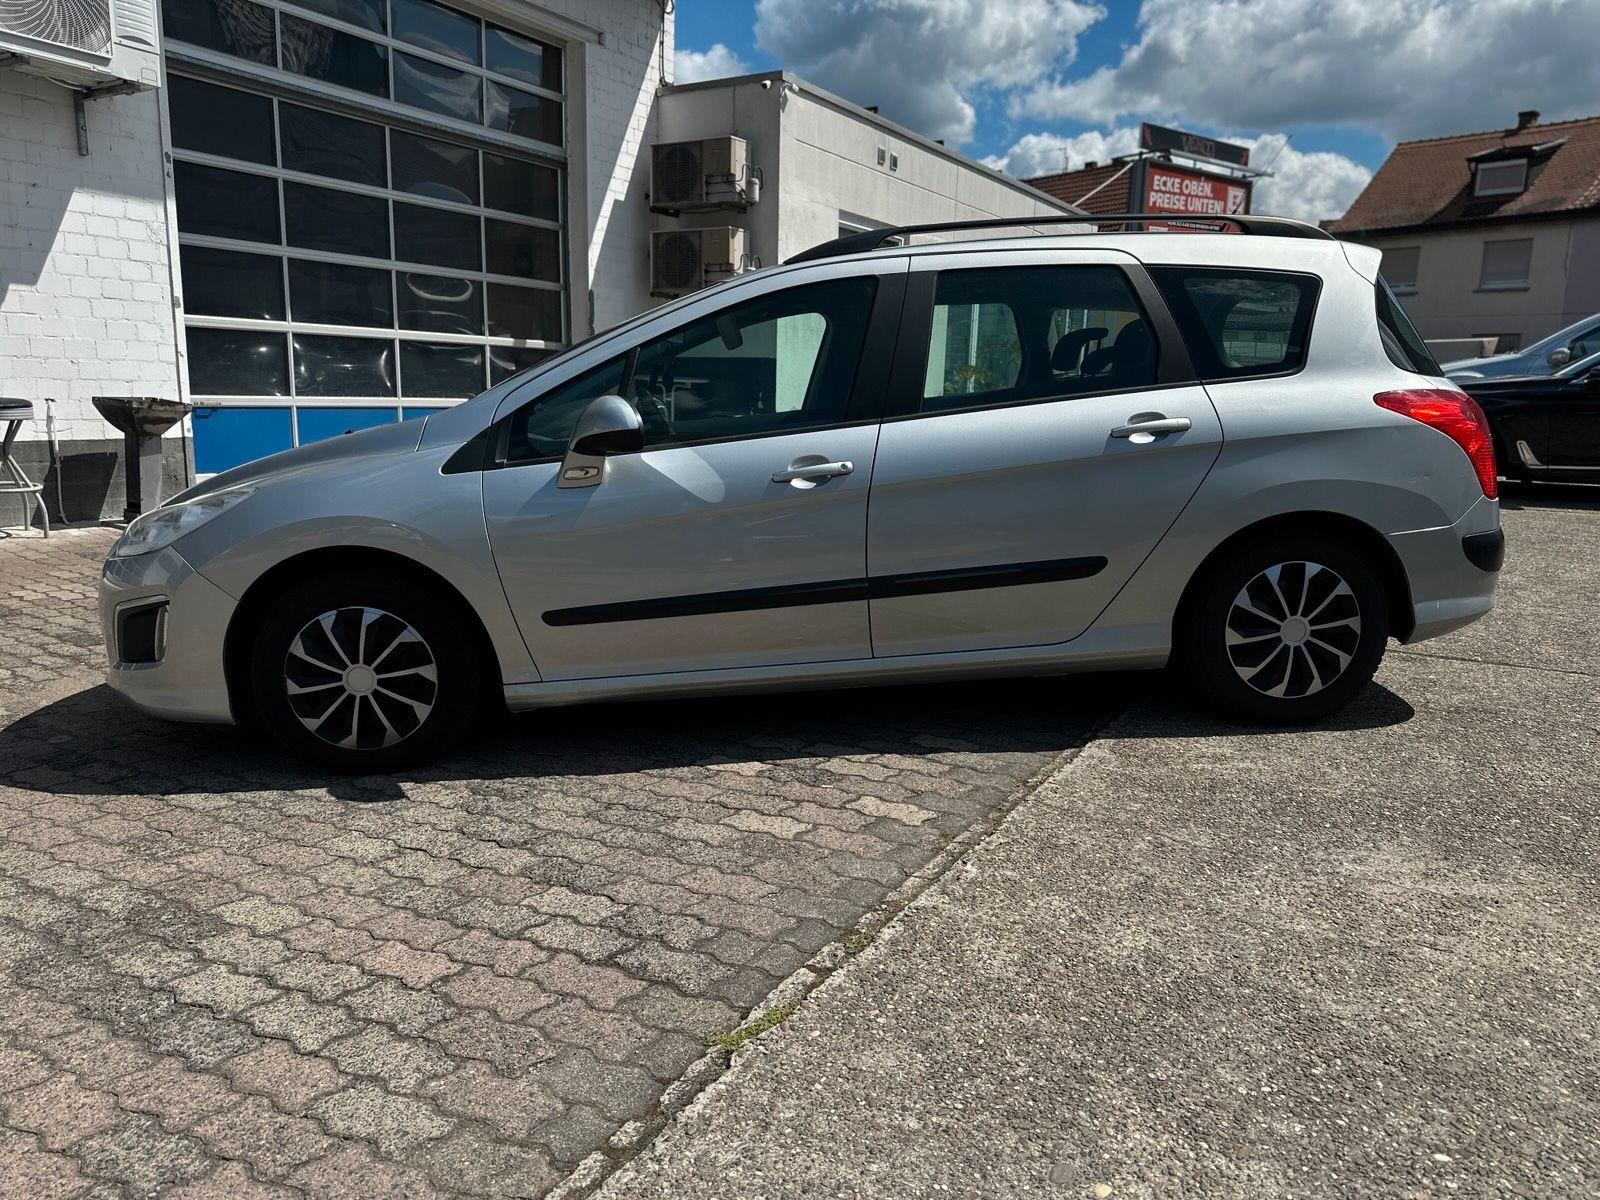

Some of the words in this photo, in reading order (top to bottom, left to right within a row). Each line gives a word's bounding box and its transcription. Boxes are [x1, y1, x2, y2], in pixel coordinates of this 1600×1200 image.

[1153, 175, 1181, 193] ECKE
[1182, 179, 1214, 198] OBEN.
[1149, 191, 1186, 210] PREISE
[1187, 196, 1225, 214] UNTEN!
